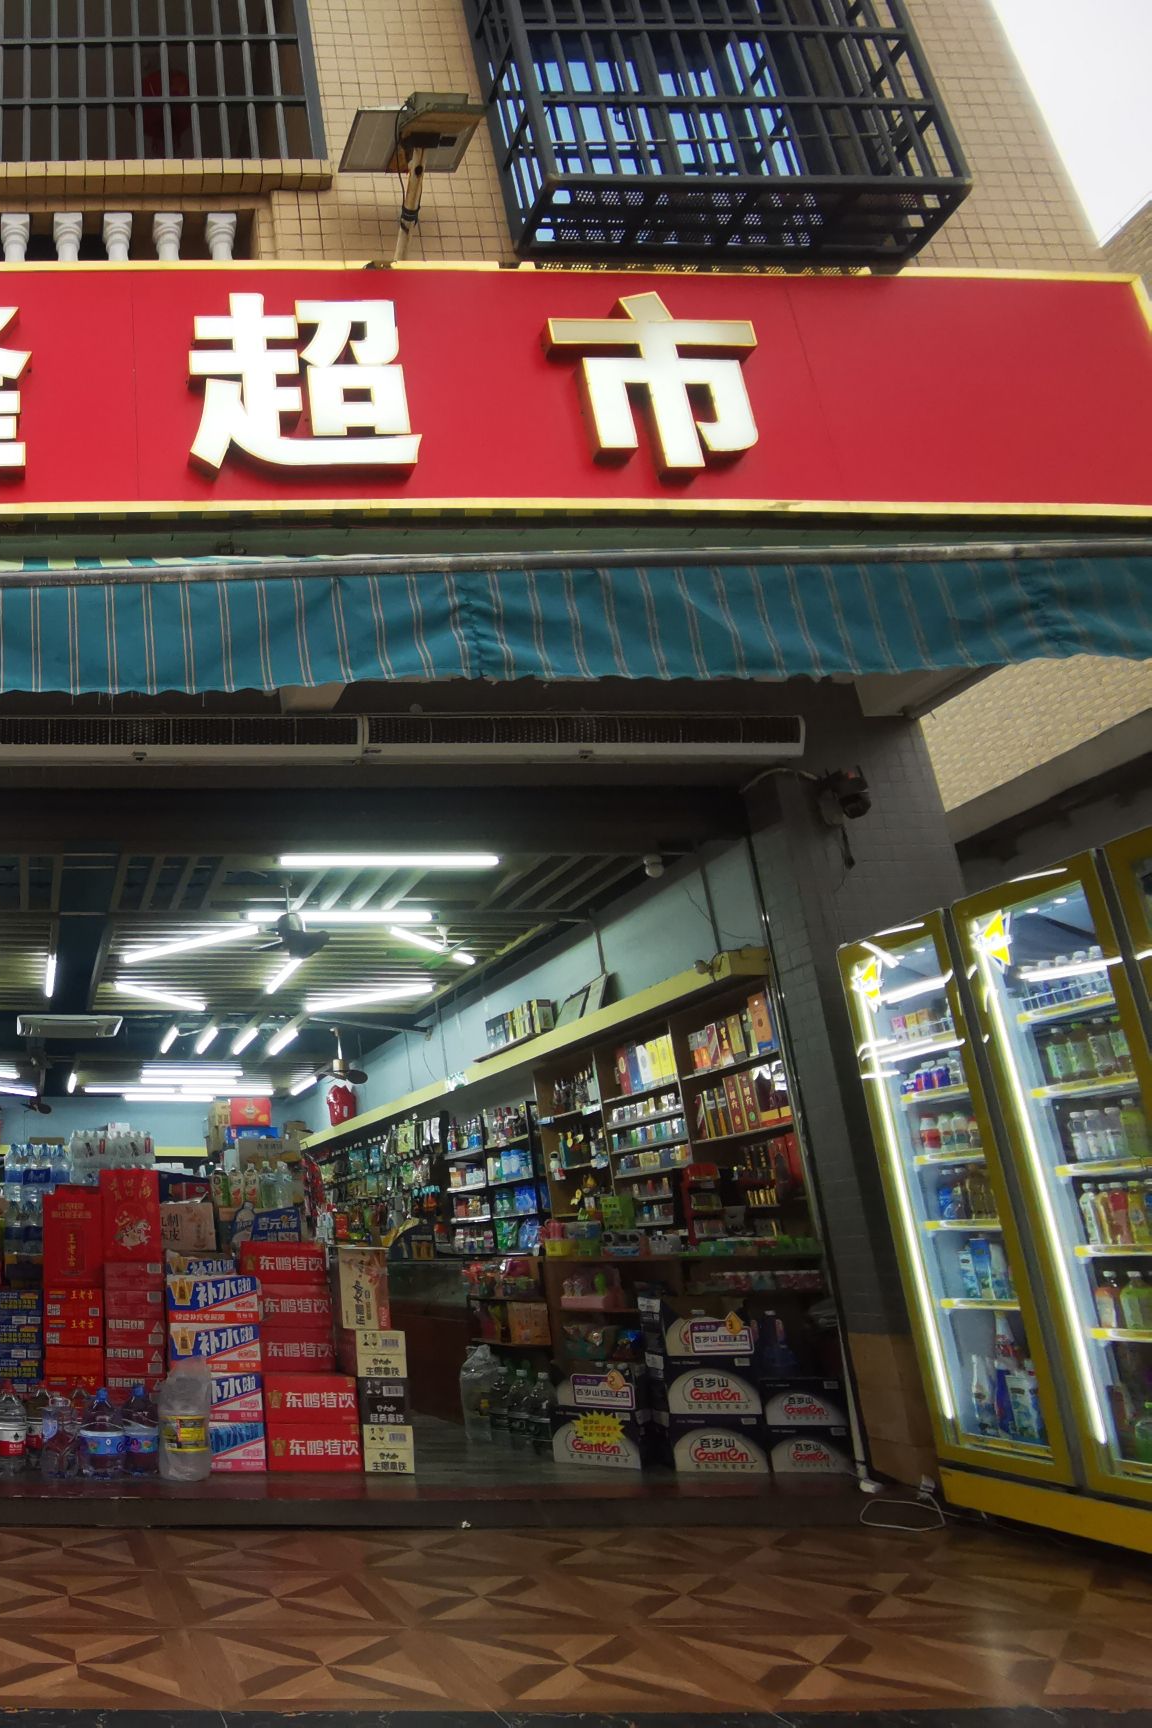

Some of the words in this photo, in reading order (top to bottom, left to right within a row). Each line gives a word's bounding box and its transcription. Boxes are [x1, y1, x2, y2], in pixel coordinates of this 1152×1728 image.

[258, 1255, 325, 1271] 东鹏特饮
[195, 1277, 252, 1308] 补水啦
[264, 1297, 330, 1314] 东鹏特饮
[197, 1325, 254, 1356] 补水啦
[267, 1341, 333, 1358] 东鹏特饮
[692, 1377, 729, 1388] 百岁山
[285, 1391, 356, 1409] 东鹏特饮
[289, 1439, 360, 1457] 东鹏特饮
[699, 1437, 736, 1449] 百岁山
